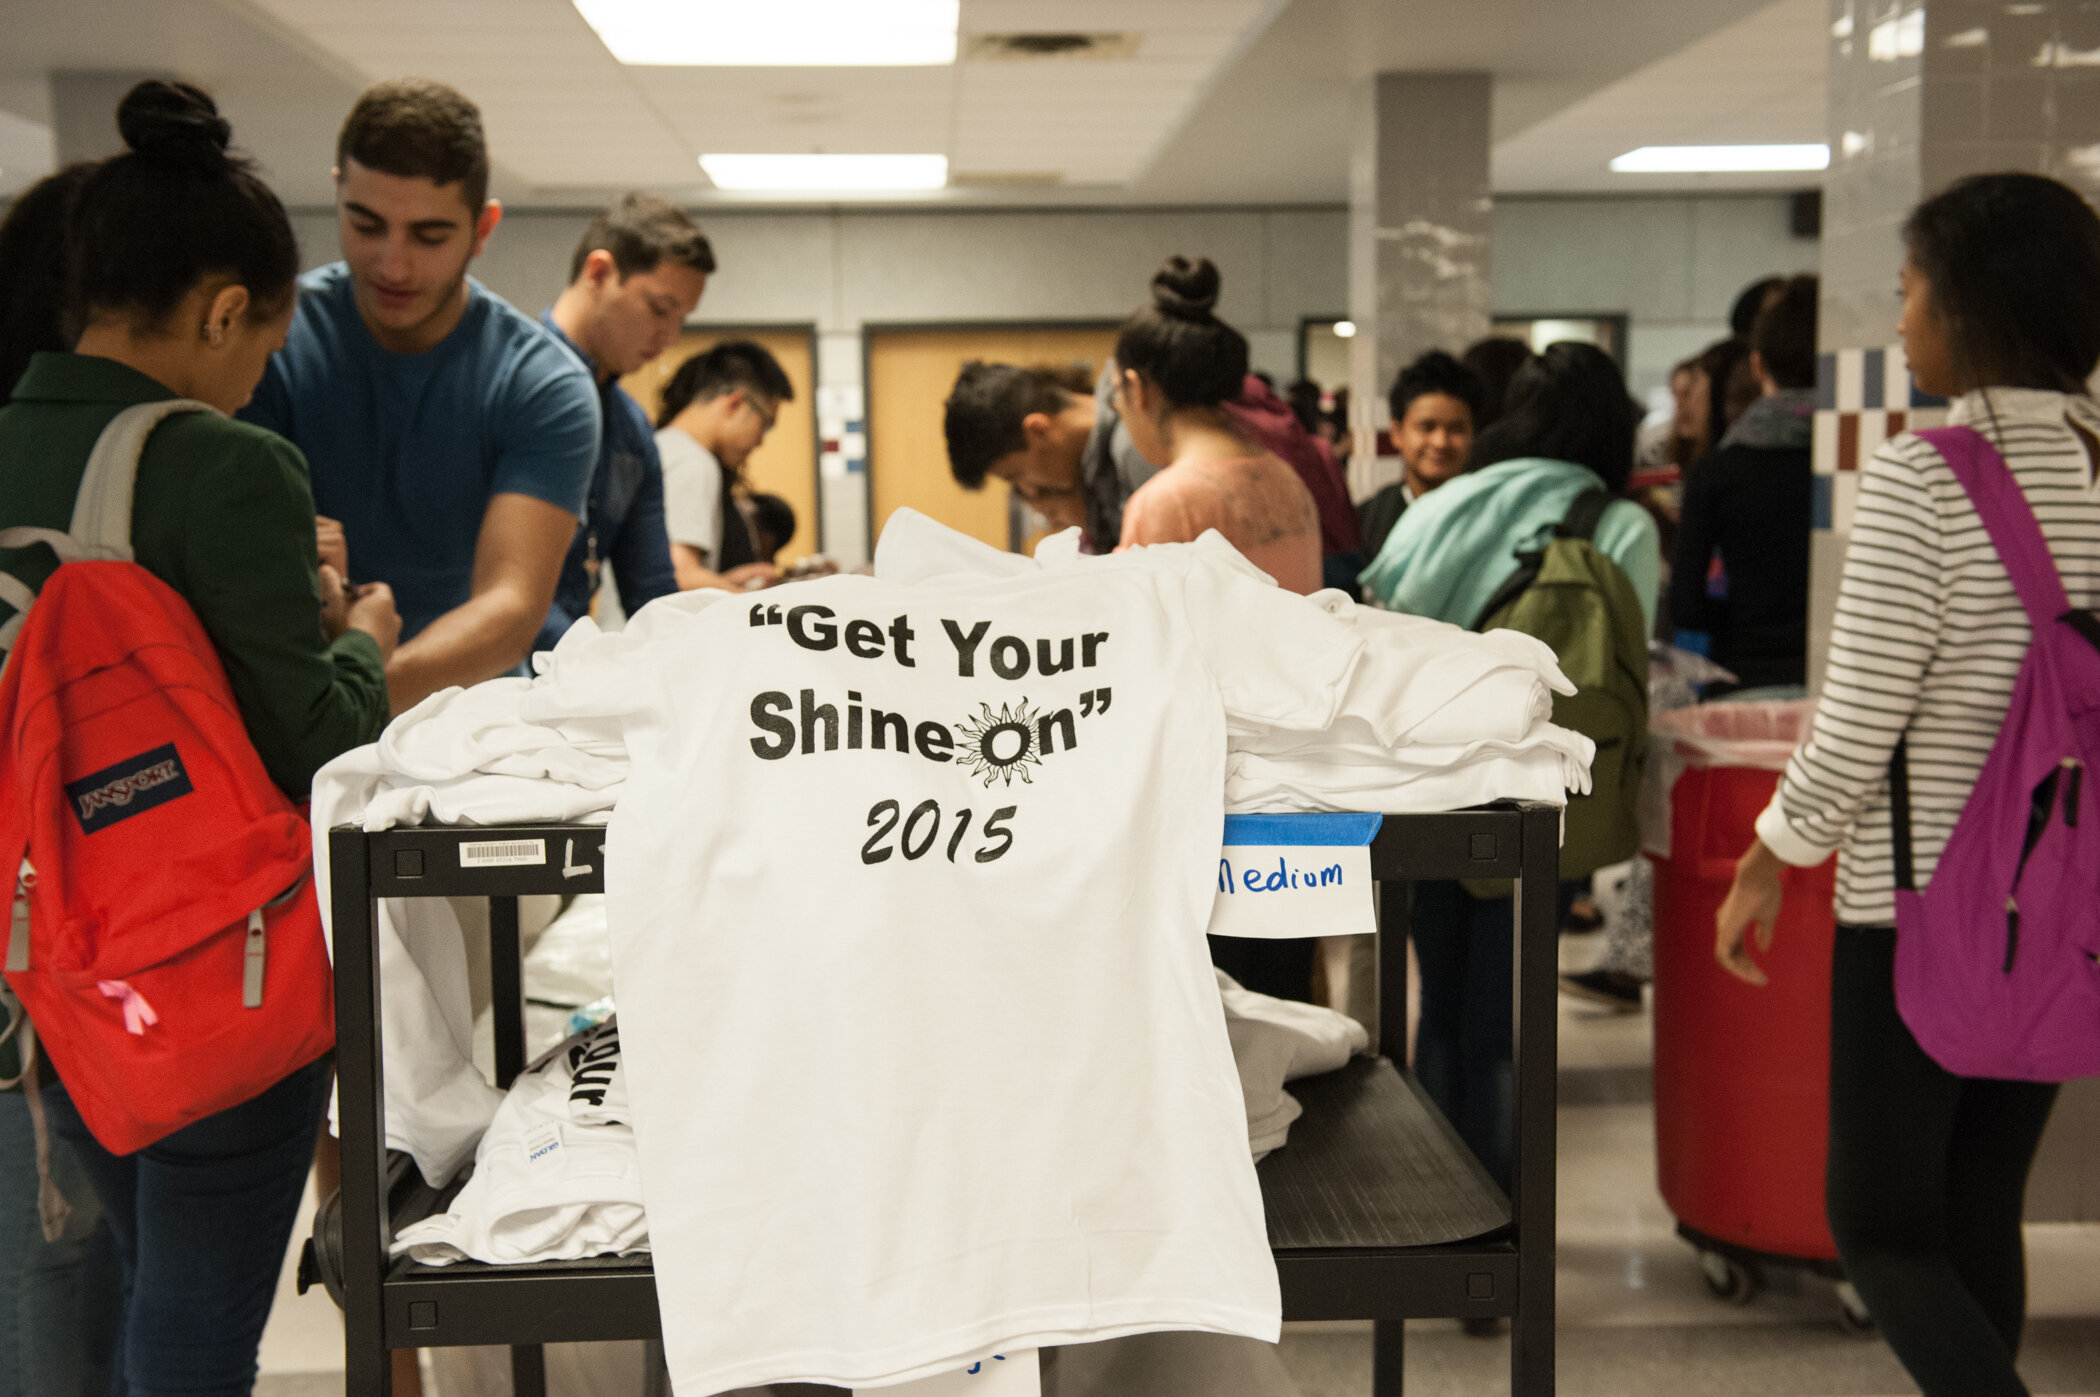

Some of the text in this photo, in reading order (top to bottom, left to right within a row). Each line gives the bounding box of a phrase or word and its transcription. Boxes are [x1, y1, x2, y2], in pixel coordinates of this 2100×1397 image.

[749, 603, 1110, 681] “Get Your
[749, 688, 955, 763] Shine
[562, 838, 604, 880] L
[861, 798, 1018, 865] 2015
